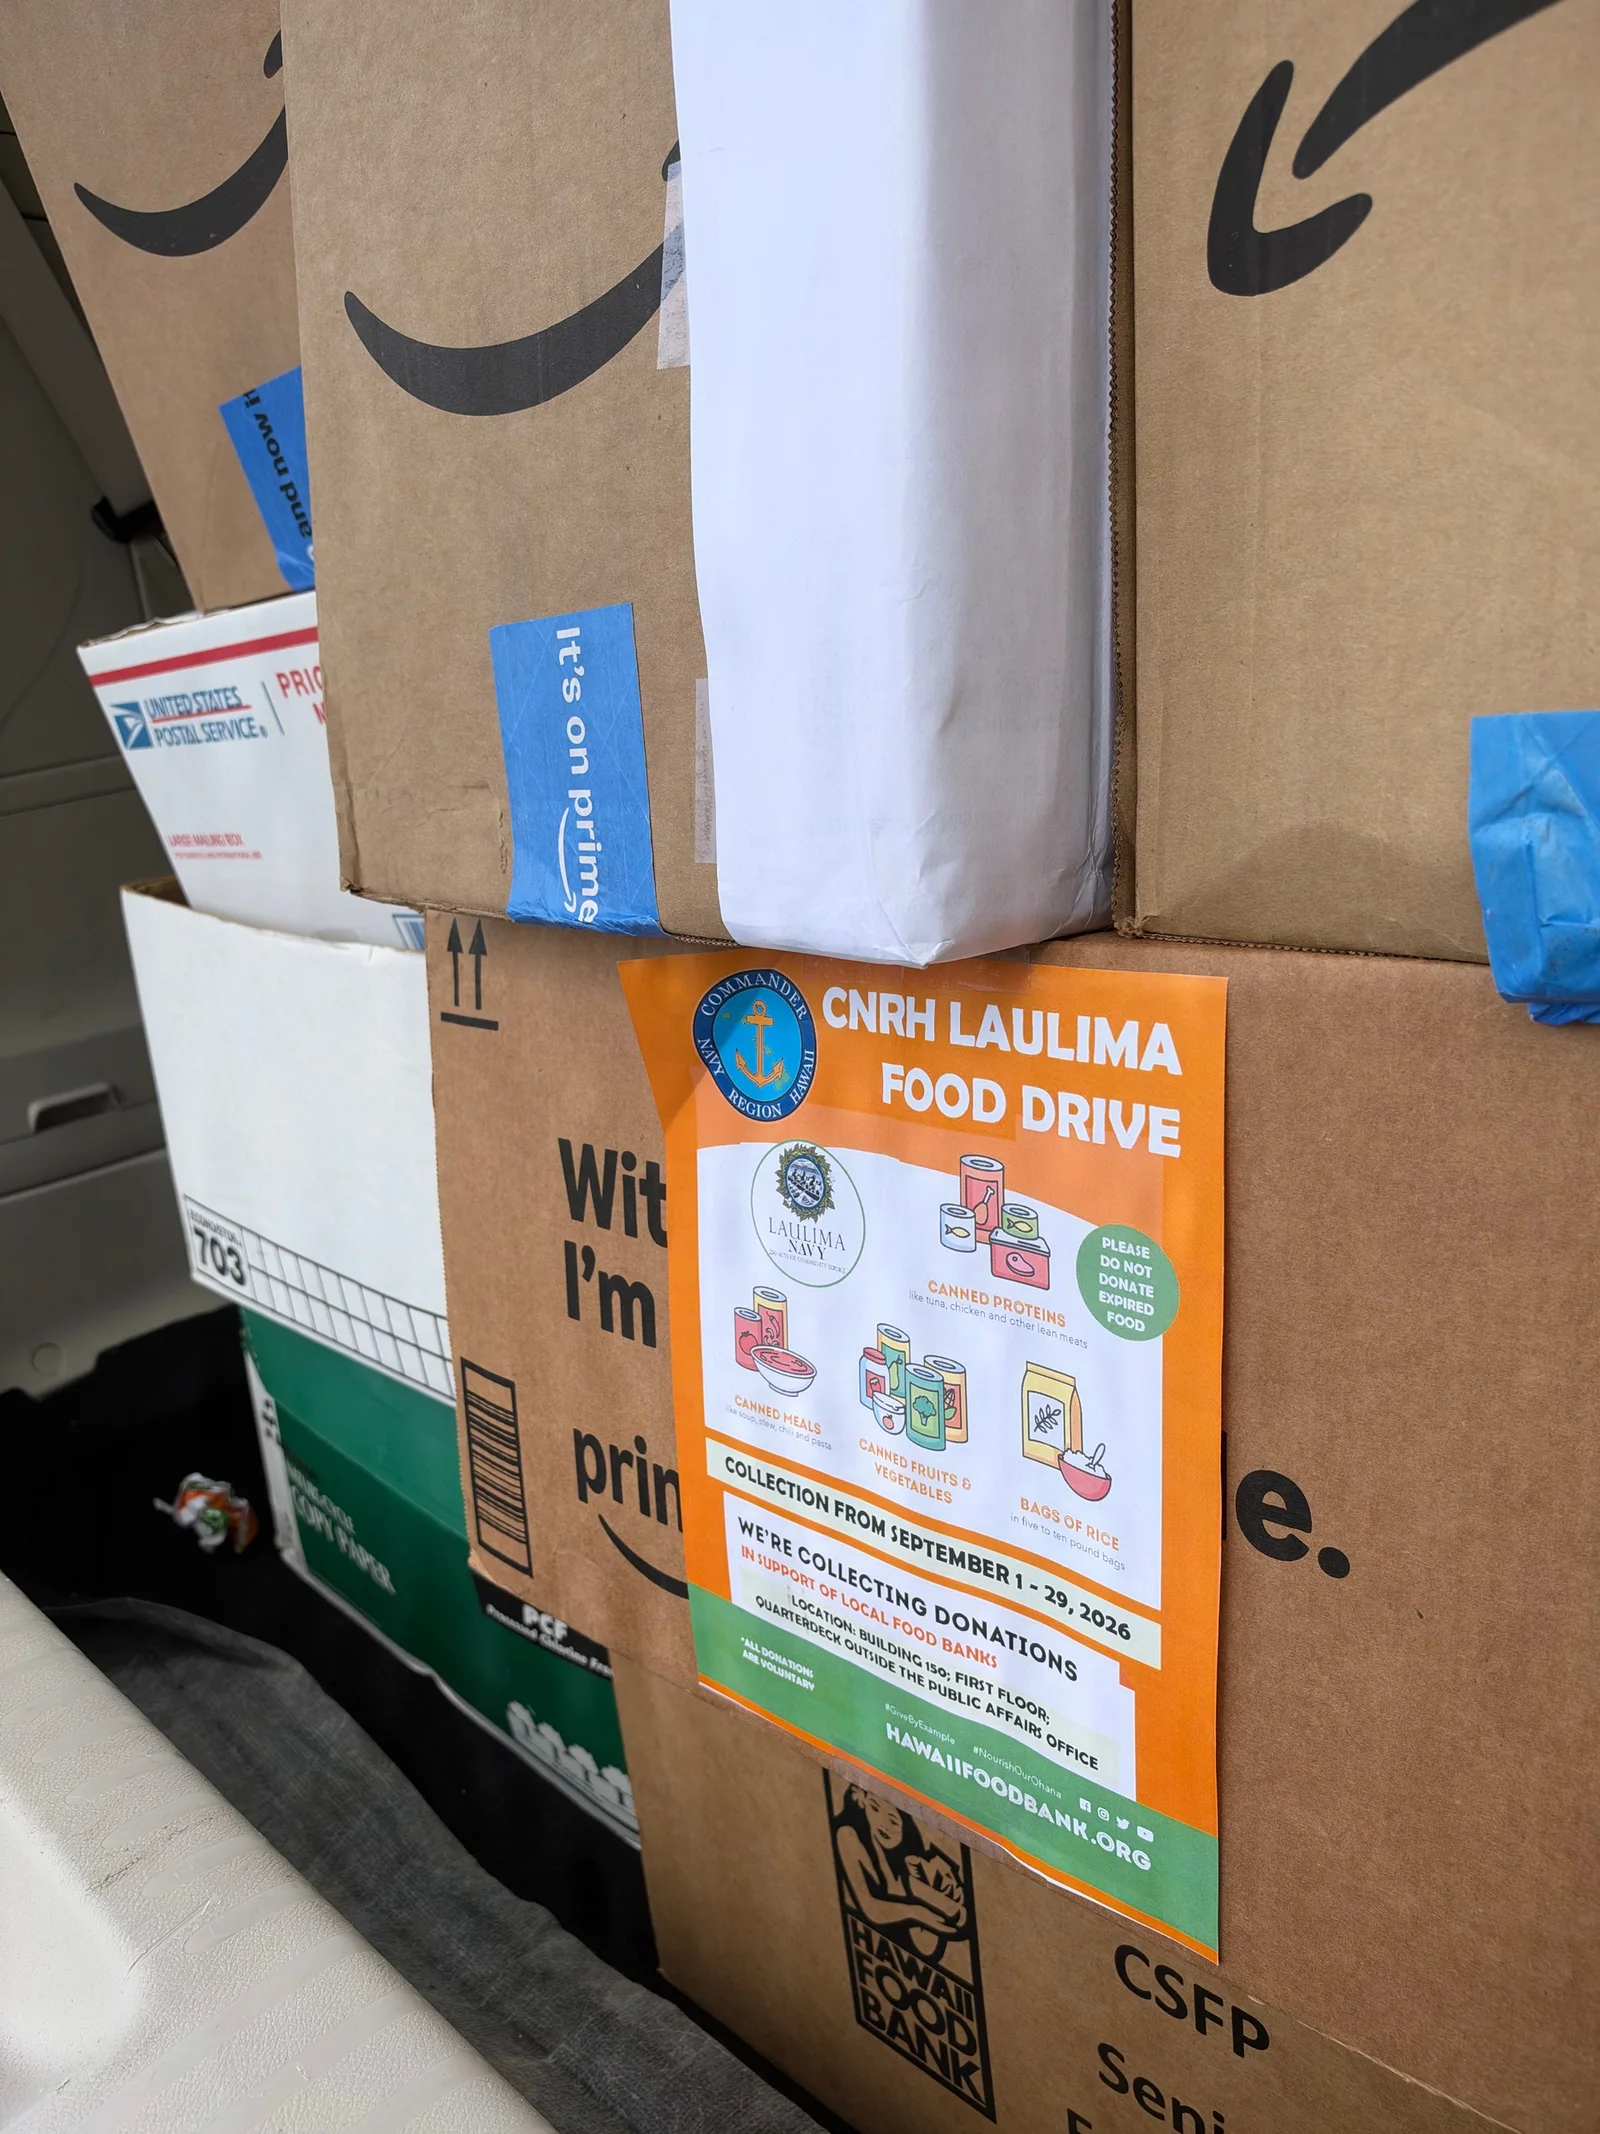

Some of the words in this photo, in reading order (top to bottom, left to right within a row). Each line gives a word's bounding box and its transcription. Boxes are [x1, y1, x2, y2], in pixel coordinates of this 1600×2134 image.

[254, 412, 289, 476] now
[280, 480, 313, 538] and
[556, 627, 585, 703] It's
[144, 693, 194, 718] UNITED
[193, 686, 243, 713] STATES
[154, 724, 203, 747] POSTAL
[202, 717, 259, 743] SERVICE
[566, 716, 589, 775] on
[568, 789, 602, 923] prime
[701, 973, 807, 1020] COMMANDER
[822, 985, 935, 1042] CNRH
[949, 1000, 1182, 1076] LAULIMA
[697, 1038, 725, 1077] NAVY
[728, 1088, 782, 1118] REGION
[789, 1049, 814, 1105] HAWAII
[881, 1062, 1006, 1124] FOOD
[1022, 1085, 1182, 1158] DRIVE
[194, 1225, 246, 1286] 703
[769, 1217, 846, 1251] LAULIMA
[789, 1239, 826, 1261] NAVY
[1102, 1237, 1150, 1259] PLEASE
[563, 1240, 656, 1348] I'm
[1099, 1272, 1154, 1298] DONATE
[1100, 1255, 1120, 1270] DO
[1124, 1260, 1152, 1278] NOT
[909, 1289, 924, 1303] like
[926, 1296, 948, 1310] tuna,
[950, 1301, 985, 1318] chicken
[988, 1311, 1007, 1324] and
[1009, 1317, 1035, 1331] other
[1037, 1323, 1057, 1338] lean
[1059, 1333, 1088, 1349] meats
[928, 1279, 990, 1306] CANNED
[993, 1295, 1066, 1328] PROTEINS
[1099, 1290, 1154, 1316] EXPIRED
[1107, 1311, 1145, 1332] FOOD
[735, 1395, 780, 1420] CANNED
[784, 1412, 821, 1435] MEALS
[796, 1431, 809, 1442] and
[812, 1438, 832, 1451] pasta
[859, 1438, 908, 1468] CANNED
[911, 1460, 958, 1487] FRUITS
[962, 1478, 971, 1490] &
[874, 1462, 952, 1504] VEGETABLES
[725, 1456, 829, 1513] COLLECTION
[834, 1499, 886, 1537] FROM
[891, 1525, 1009, 1584] SEPTEMBER
[1015, 1573, 1023, 1590] 1
[1044, 1585, 1074, 1615] 29,
[1079, 1602, 1131, 1641] 2026
[1011, 1513, 1019, 1523] in
[1022, 1516, 1038, 1530] five
[1041, 1525, 1050, 1535] to
[1053, 1530, 1067, 1543] ten
[1070, 1538, 1100, 1558] pound
[1102, 1552, 1125, 1571] bags
[1020, 1497, 1060, 1523] BAGS
[1064, 1515, 1082, 1532] OF
[1086, 1524, 1119, 1551] RICE
[522, 1604, 568, 1640] PCF
[738, 1516, 793, 1557] WE'RE
[798, 1546, 927, 1617] COLLECTING
[935, 1605, 1078, 1682] DONATIONS
[741, 1545, 755, 1562] IN
[757, 1553, 815, 1590] SUPPORT
[819, 1583, 838, 1600] OF
[841, 1593, 889, 1626] LOCAL
[893, 1616, 937, 1646] FOOD
[942, 1637, 998, 1669] BANKS
[742, 1649, 760, 1665] ARE
[760, 1658, 815, 1692] VOLUNTARY
[755, 1595, 842, 1646] QUARTERDECK
[844, 1638, 896, 1674] OUTSIDE
[899, 1664, 925, 1688] THE
[928, 1679, 981, 1710] PUBLIC
[985, 1702, 1042, 1740] AFFAIRS
[1046, 1733, 1099, 1771] OFFICE
[761, 1646, 814, 1679] DONATIONS
[791, 1594, 856, 1636] LOCATION:
[859, 1628, 923, 1668] BUILDING
[925, 1661, 951, 1682] 150;
[955, 1671, 994, 1695] FIRST
[998, 1687, 1050, 1726] FLOOR;
[884, 1703, 956, 1745] #GiveByExample
[973, 1746, 1063, 1799] #NourishOurOhana
[886, 1722, 1151, 1871] HAWAIIFOODBANK.ORG
[850, 1915, 975, 2023] HAWAII
[854, 1948, 977, 2056] FOOD
[1113, 1944, 1270, 2058] CSFP
[860, 1987, 986, 2107] BANK
